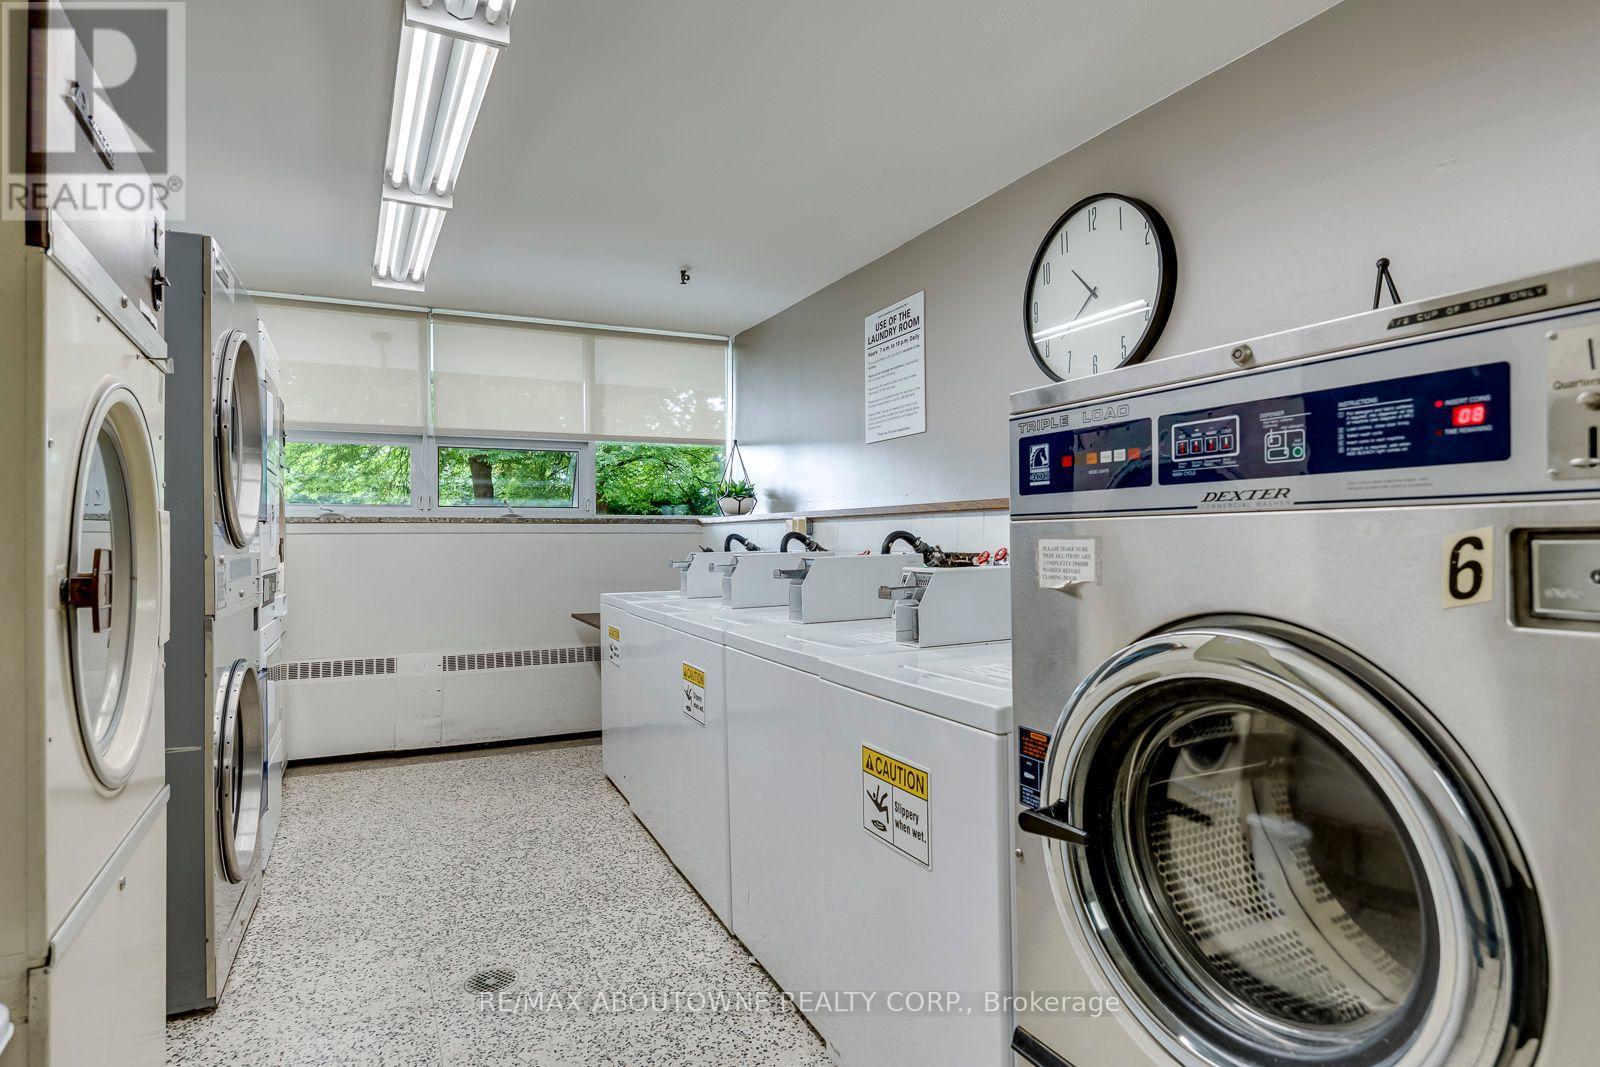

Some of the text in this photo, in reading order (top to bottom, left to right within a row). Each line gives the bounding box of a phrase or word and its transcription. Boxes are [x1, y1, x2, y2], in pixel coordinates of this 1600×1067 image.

[1088, 206, 1097, 232] 12
[1060, 230, 1069, 255] 11
[1144, 220, 1150, 246] 2
[1042, 262, 1051, 286] 10
[1033, 301, 1039, 324] 9
[1416, 310, 1439, 322] CUP
[1446, 305, 1461, 315] OF
[1469, 296, 1501, 311] SOAP
[1509, 286, 1545, 301] ONLY
[868, 315, 920, 345] LAUNDRY ROOM
[876, 319, 887, 331] USE
[888, 314, 897, 326] OF
[899, 308, 911, 321] THE
[1120, 335, 1127, 360] 5
[1067, 351, 1072, 374] 7
[1018, 404, 1130, 434] TRIPLE LOAD
[1457, 406, 1485, 424] 08
[1201, 487, 1291, 502] DEXTER
[1449, 536, 1484, 600] 6
[875, 756, 924, 795] CAUTION
[894, 800, 919, 825] Slippery
[894, 819, 927, 844] when wet.
